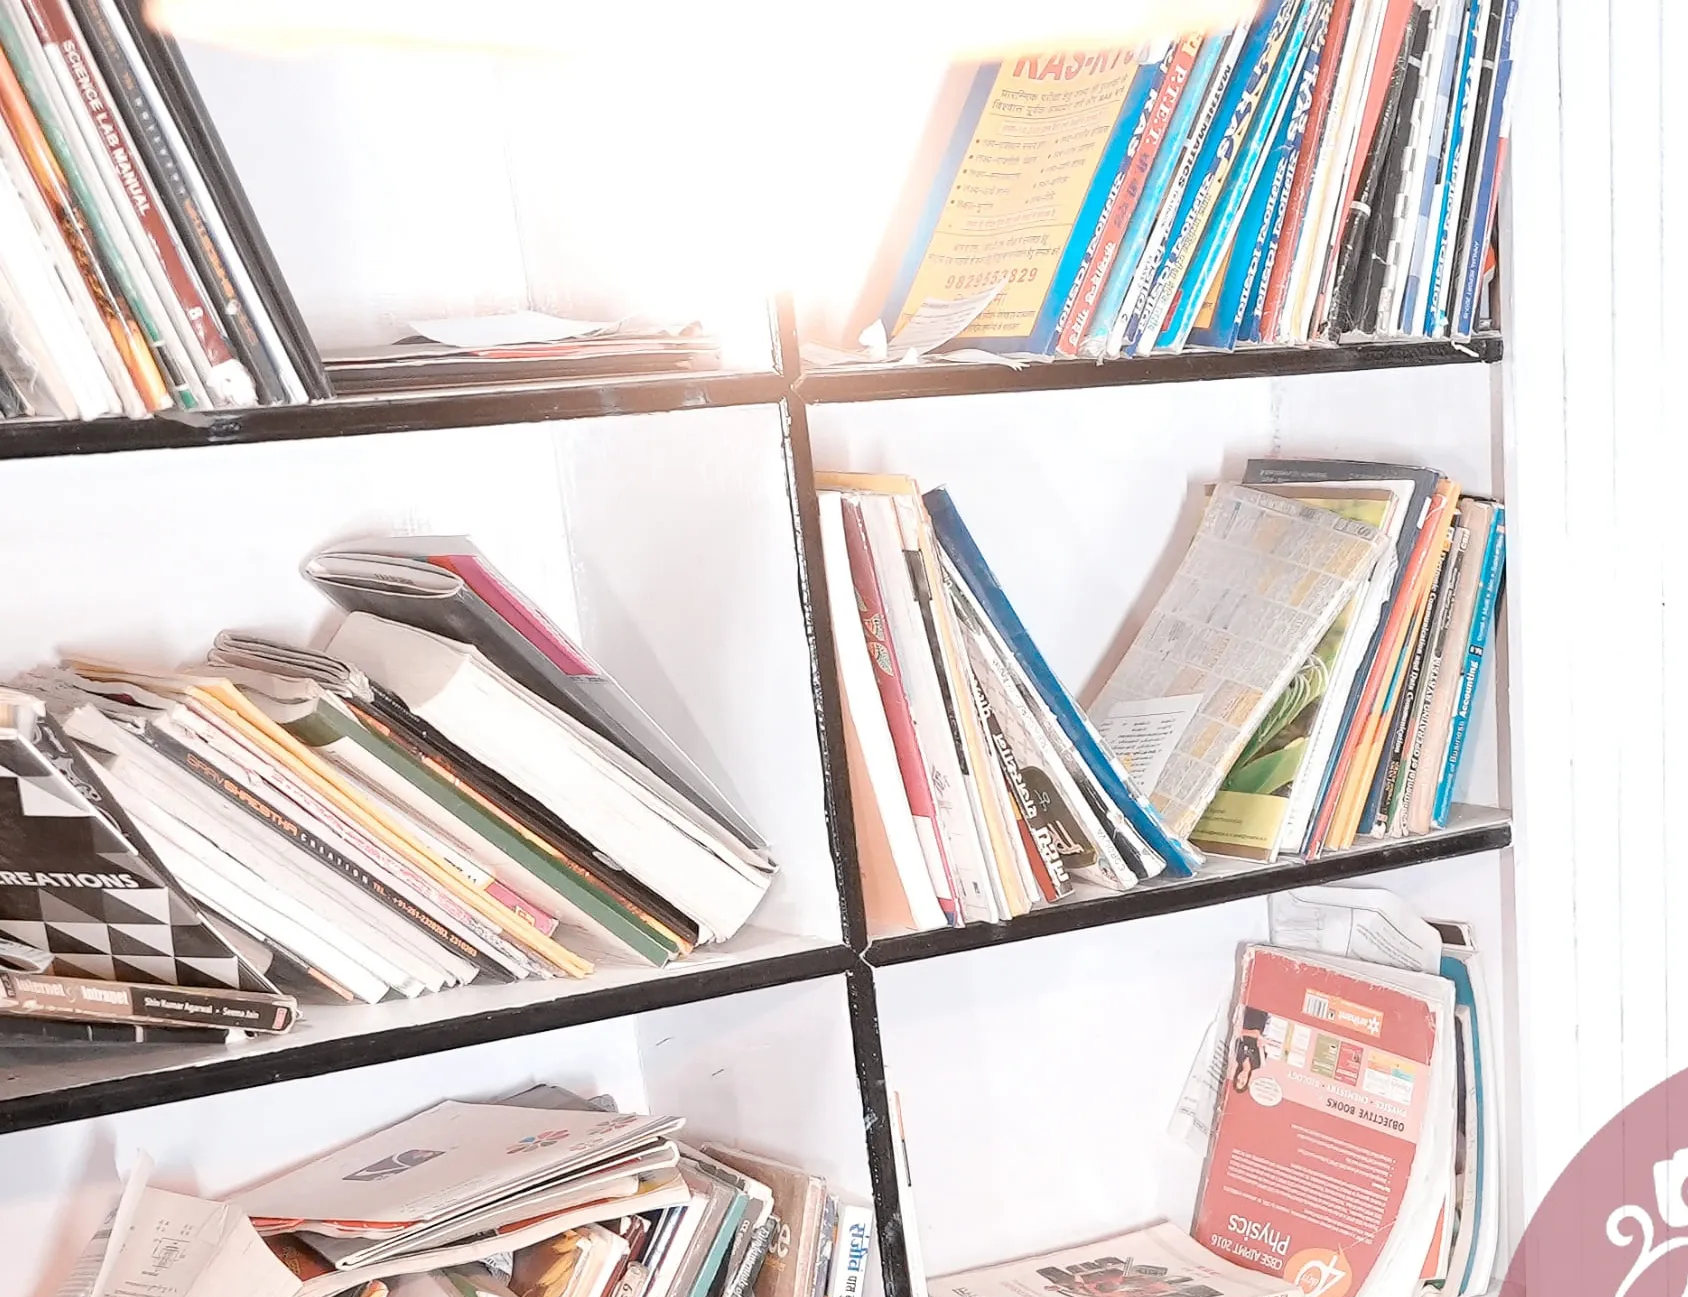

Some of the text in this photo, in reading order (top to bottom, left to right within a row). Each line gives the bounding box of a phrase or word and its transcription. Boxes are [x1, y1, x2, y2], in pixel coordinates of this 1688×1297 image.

[61, 37, 152, 216] SCIENCE LAB MANUAL
[1177, 64, 1232, 187] MATHEMATICS
[1393, 591, 1436, 753] Communication Communication
[1457, 660, 1479, 718] Accounting
[992, 730, 1069, 886] लक्ष्य राजस्थान
[0, 870, 138, 888] REATIONS
[1325, 1096, 1405, 1132] OBJECTIVE BOOKS
[845, 1223, 869, 1272] संजीव
[1208, 1233, 1284, 1271] CBSE AIPMT 2016
[1224, 1207, 1294, 1256] Physics
[844, 1275, 858, 1292] पास
